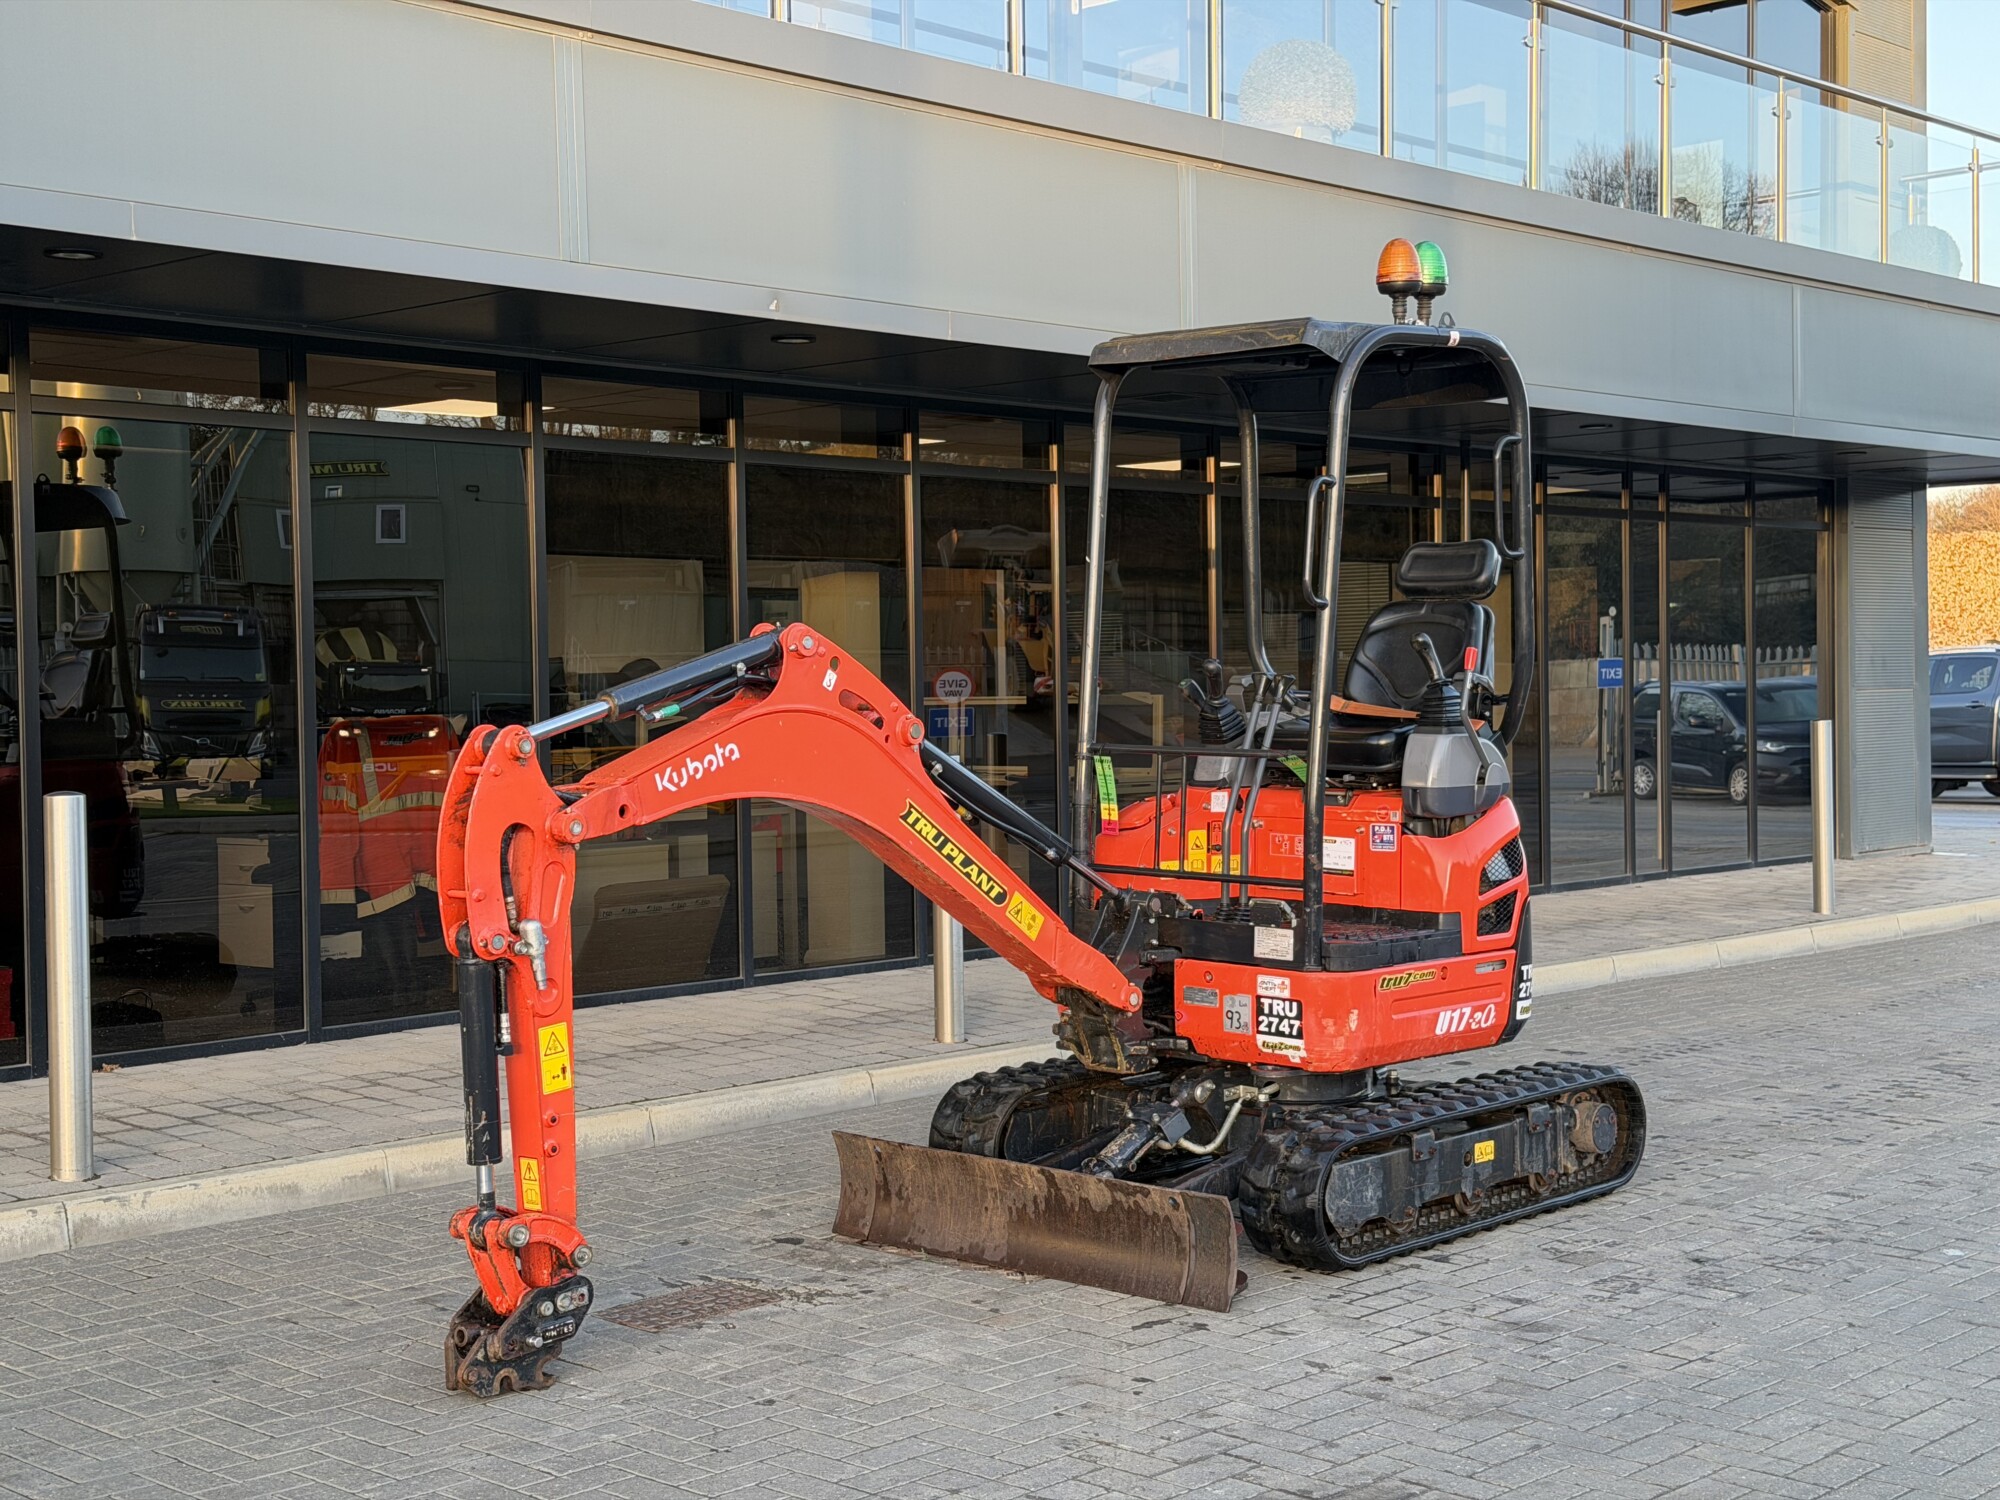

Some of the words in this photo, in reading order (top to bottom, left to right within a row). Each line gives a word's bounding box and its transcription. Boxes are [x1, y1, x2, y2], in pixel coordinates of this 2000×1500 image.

[654, 742, 741, 792] Kubota
[906, 807, 945, 847] TRU
[940, 842, 1004, 899] PLANT
[1518, 982, 1533, 998] 27
[1260, 998, 1298, 1018] TRU
[1258, 1015, 1301, 1036] 2747
